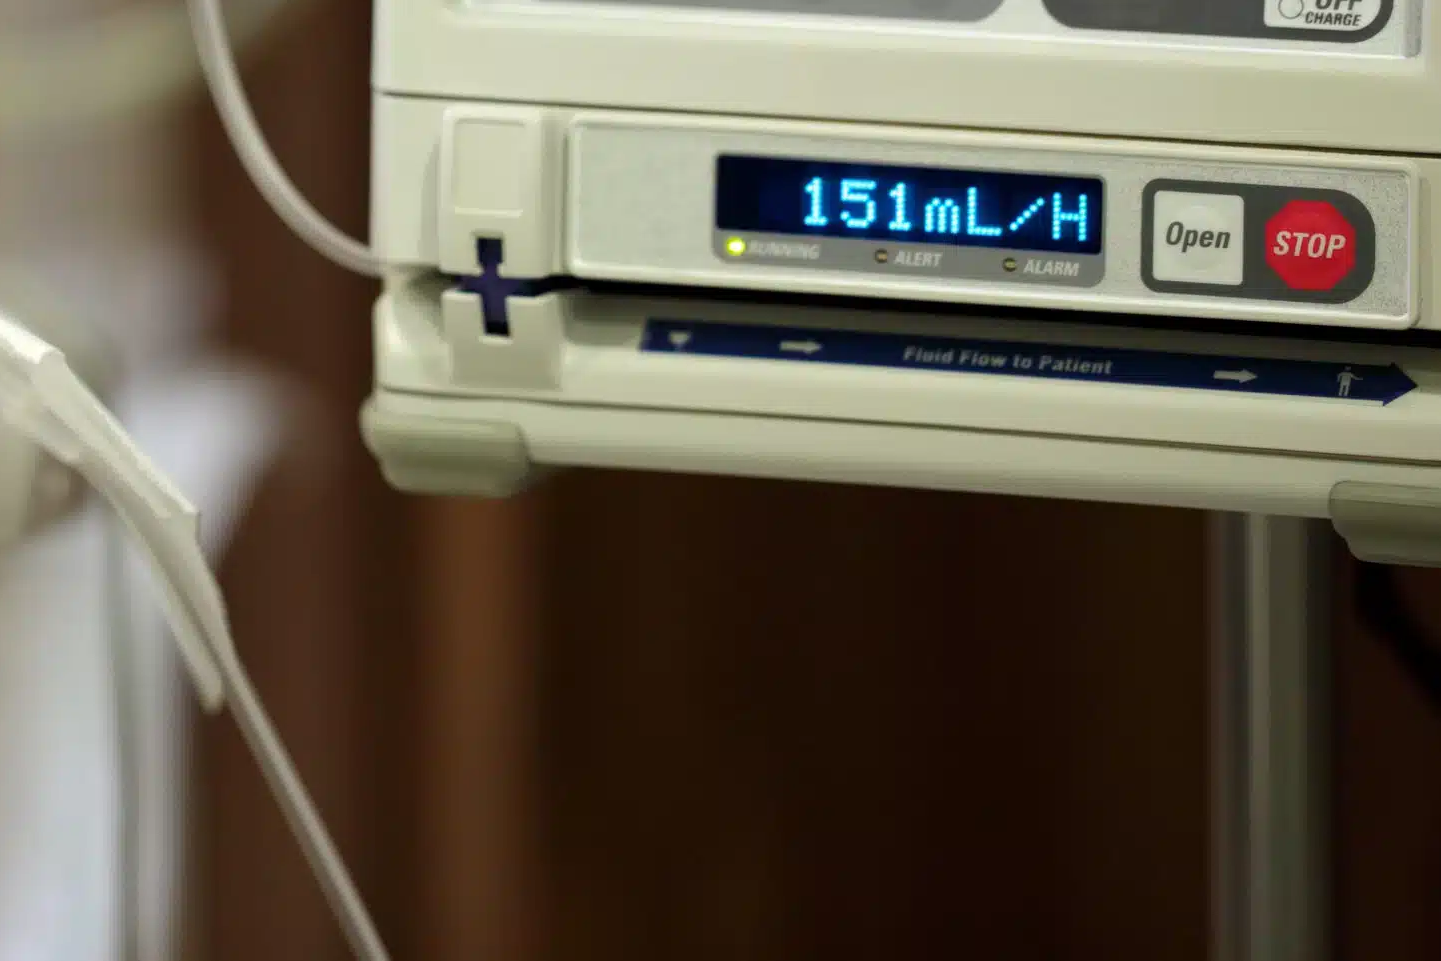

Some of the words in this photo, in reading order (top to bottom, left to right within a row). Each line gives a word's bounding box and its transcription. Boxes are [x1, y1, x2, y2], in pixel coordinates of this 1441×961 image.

[1305, 11, 1361, 27] CHARGE
[804, 176, 1088, 242] 151mL/H
[1166, 221, 1231, 253] Open
[1273, 230, 1346, 259] STOP
[749, 240, 820, 260] RUNNING
[894, 251, 942, 267] ALERT
[1023, 259, 1080, 277] ALARM
[903, 346, 955, 364] Fluid
[959, 349, 1007, 368] Flow
[1012, 354, 1032, 369] to
[1039, 355, 1113, 374] Patient
